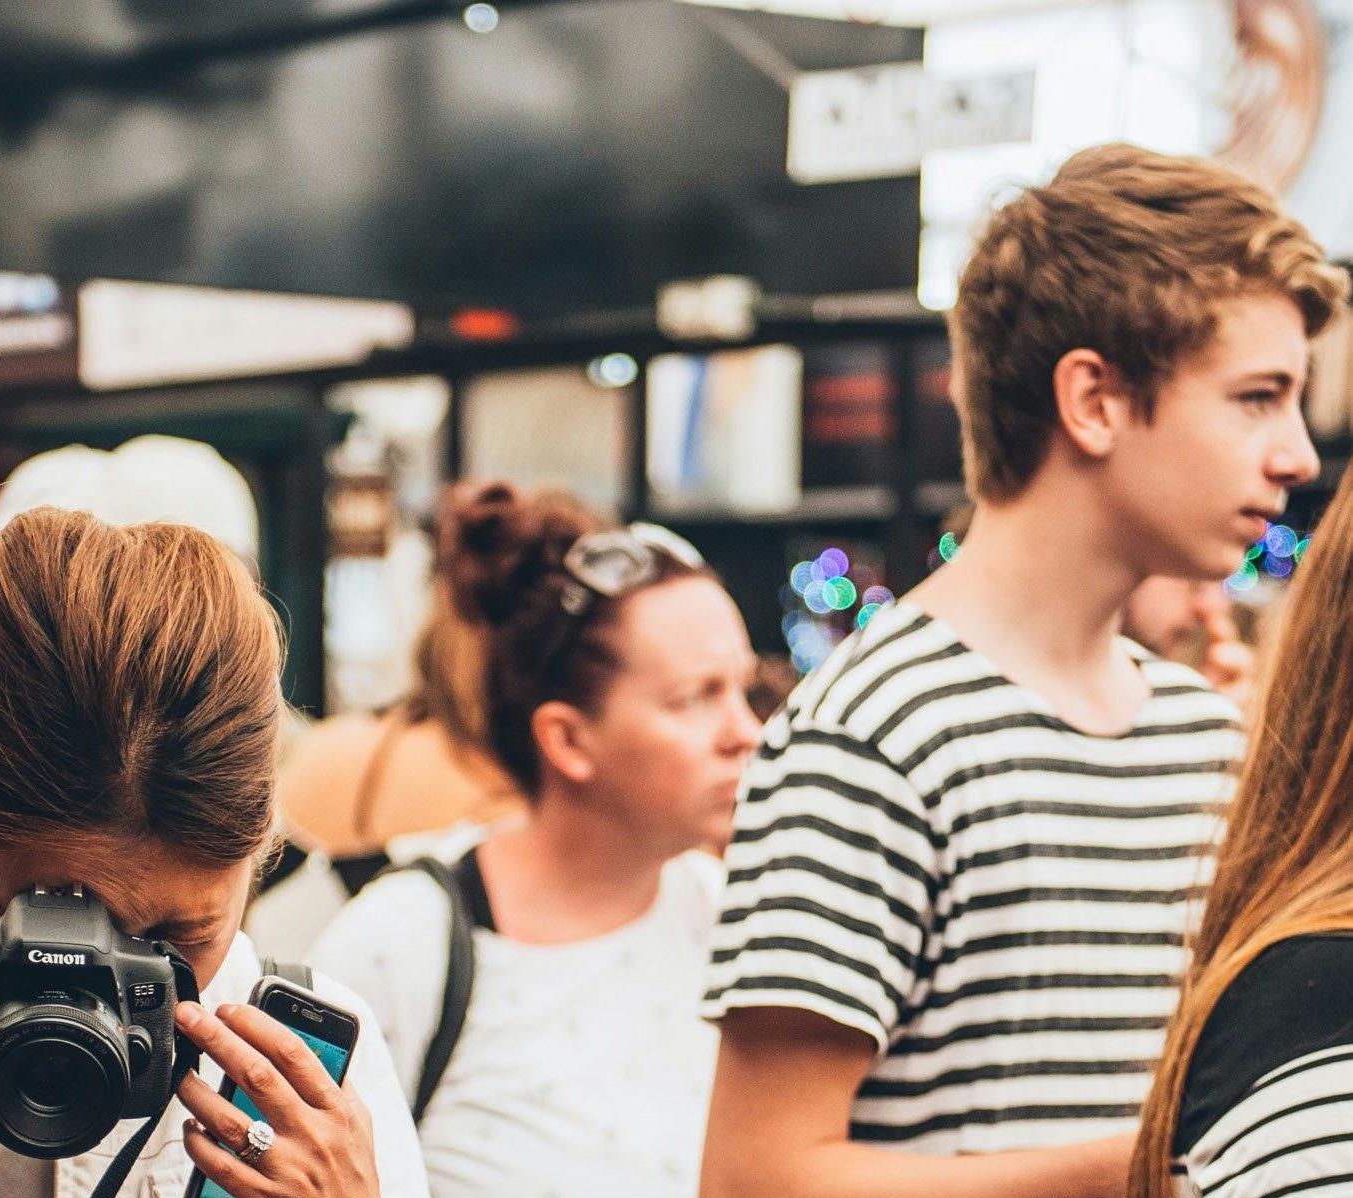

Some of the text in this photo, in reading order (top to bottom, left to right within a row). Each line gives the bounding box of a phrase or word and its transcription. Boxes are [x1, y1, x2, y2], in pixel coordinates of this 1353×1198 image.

[28, 949, 85, 966] Canon
[134, 984, 155, 996] EOS
[134, 997, 155, 1007] 750
